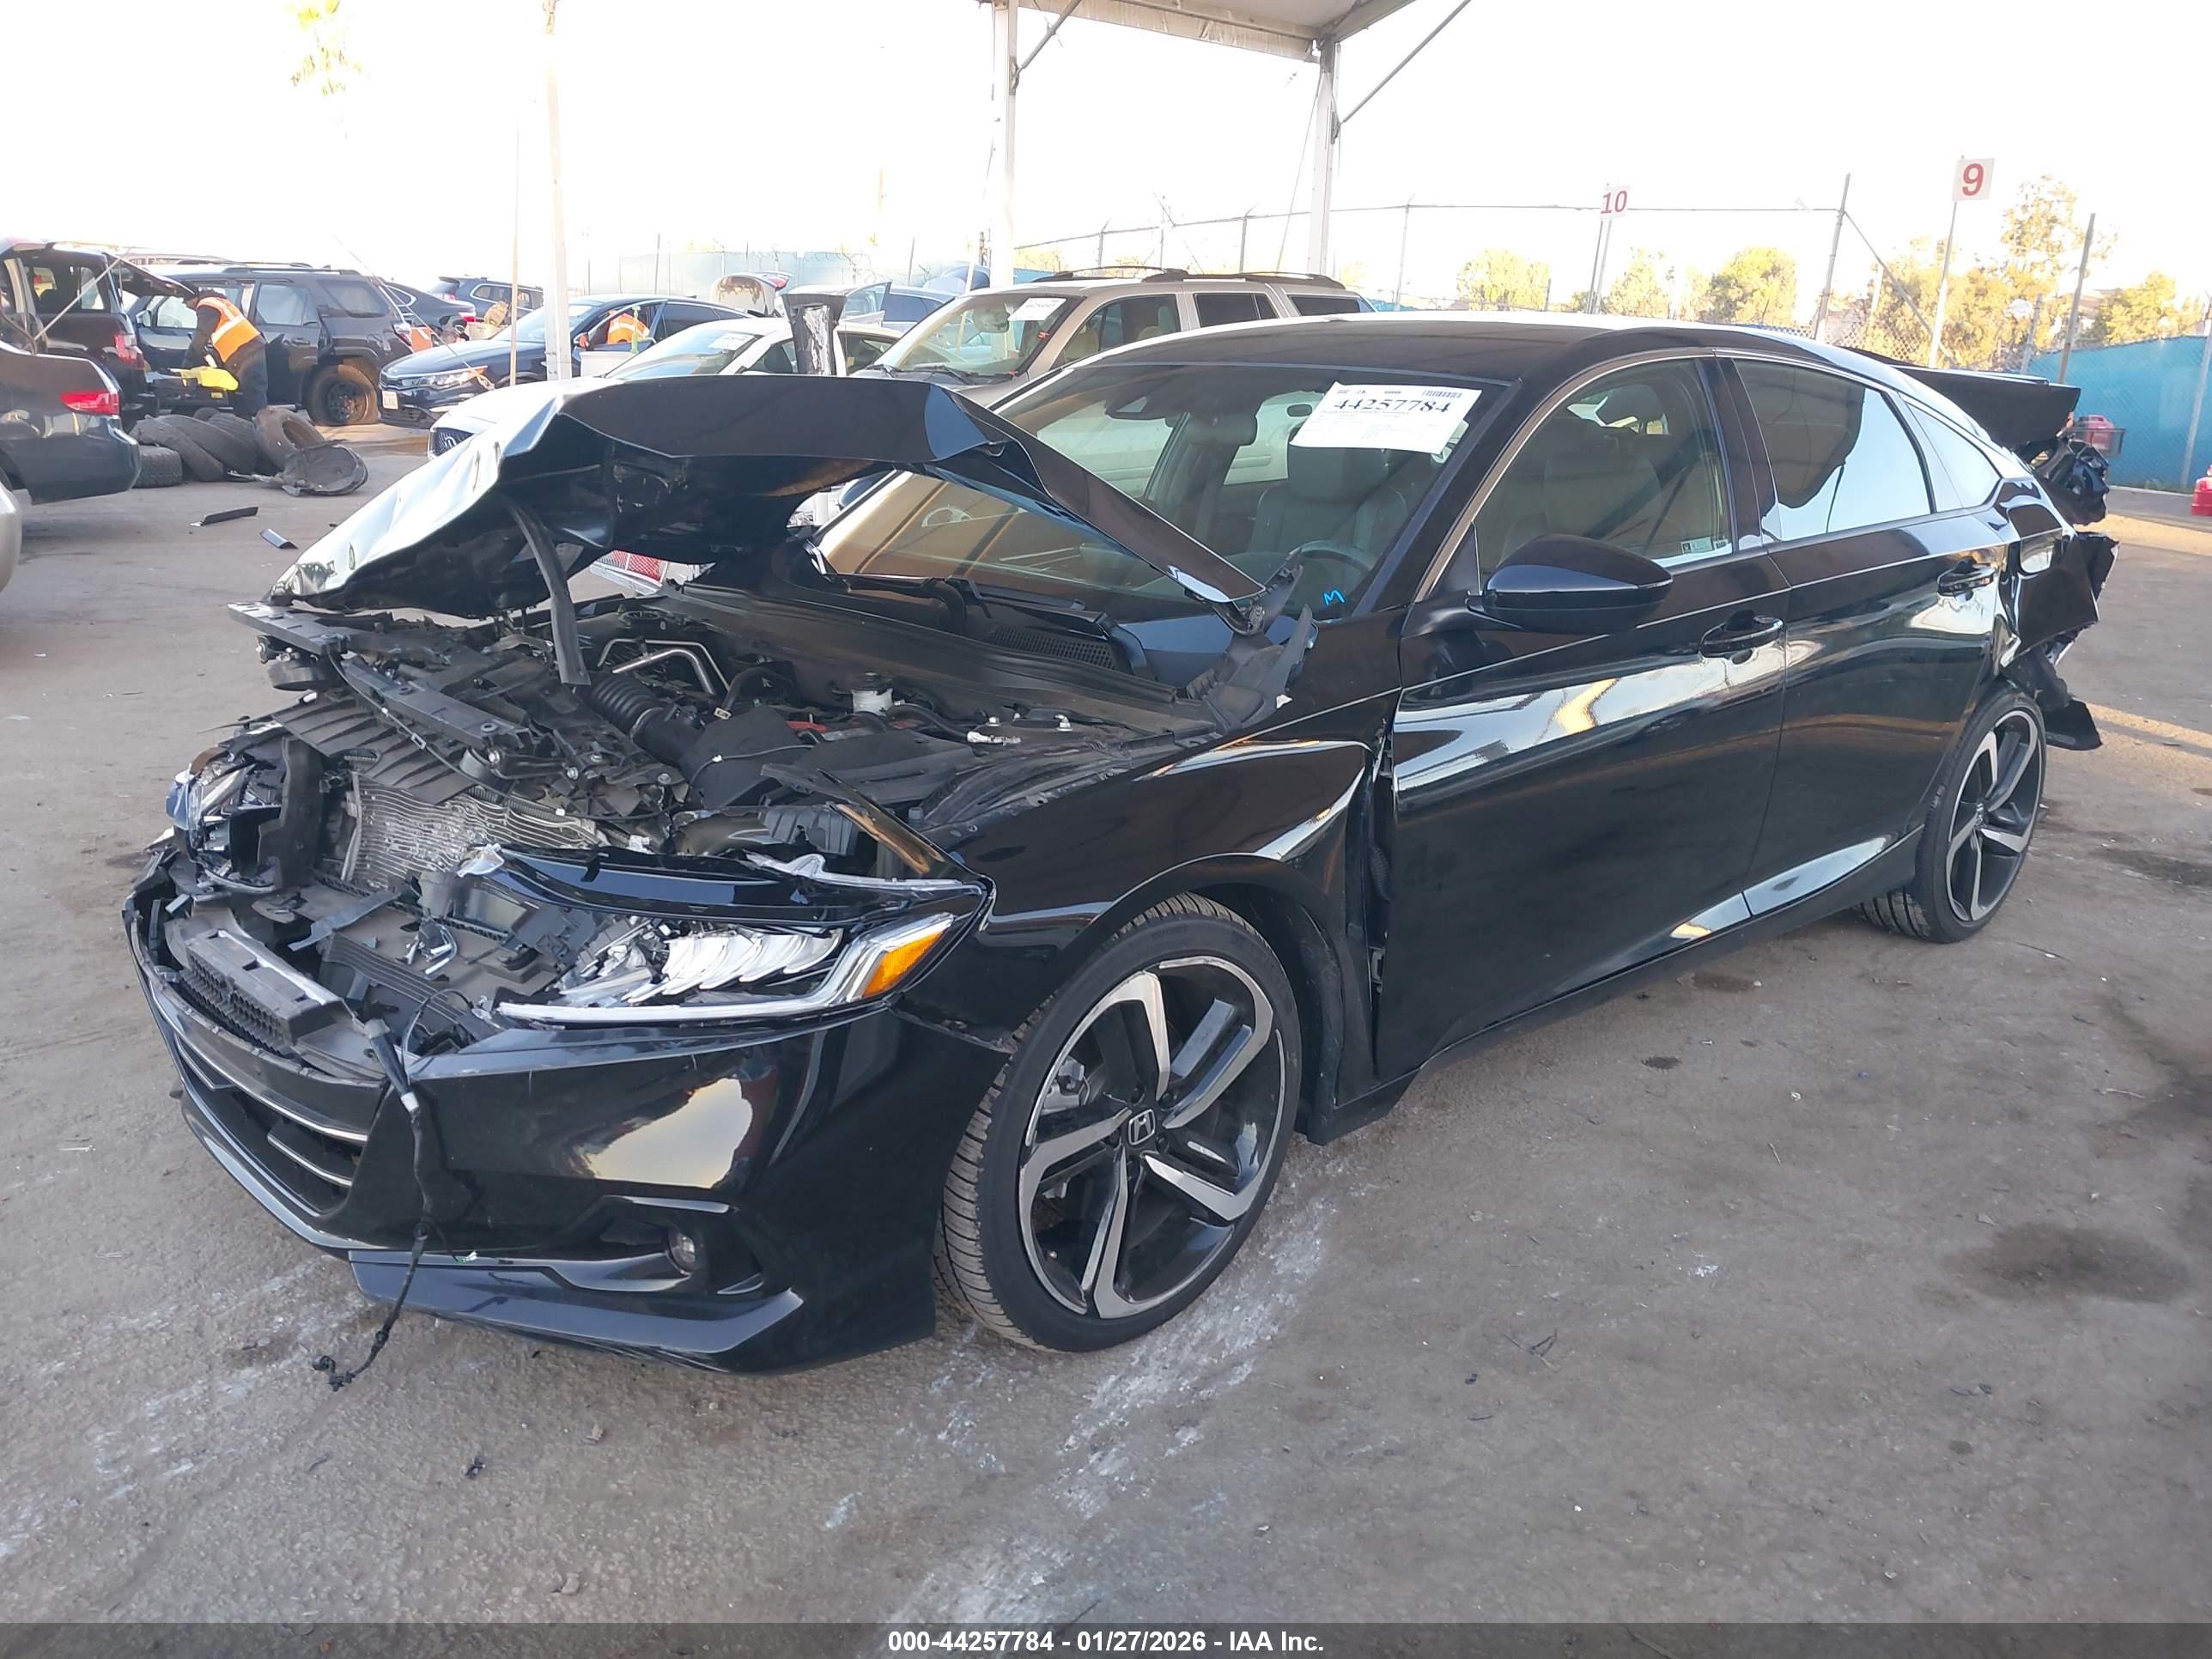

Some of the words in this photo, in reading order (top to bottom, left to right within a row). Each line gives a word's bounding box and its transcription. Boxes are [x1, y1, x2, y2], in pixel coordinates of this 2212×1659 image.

[1962, 163, 1984, 197] 9
[1601, 191, 1628, 214] 10
[1334, 398, 1452, 413] 44257784
